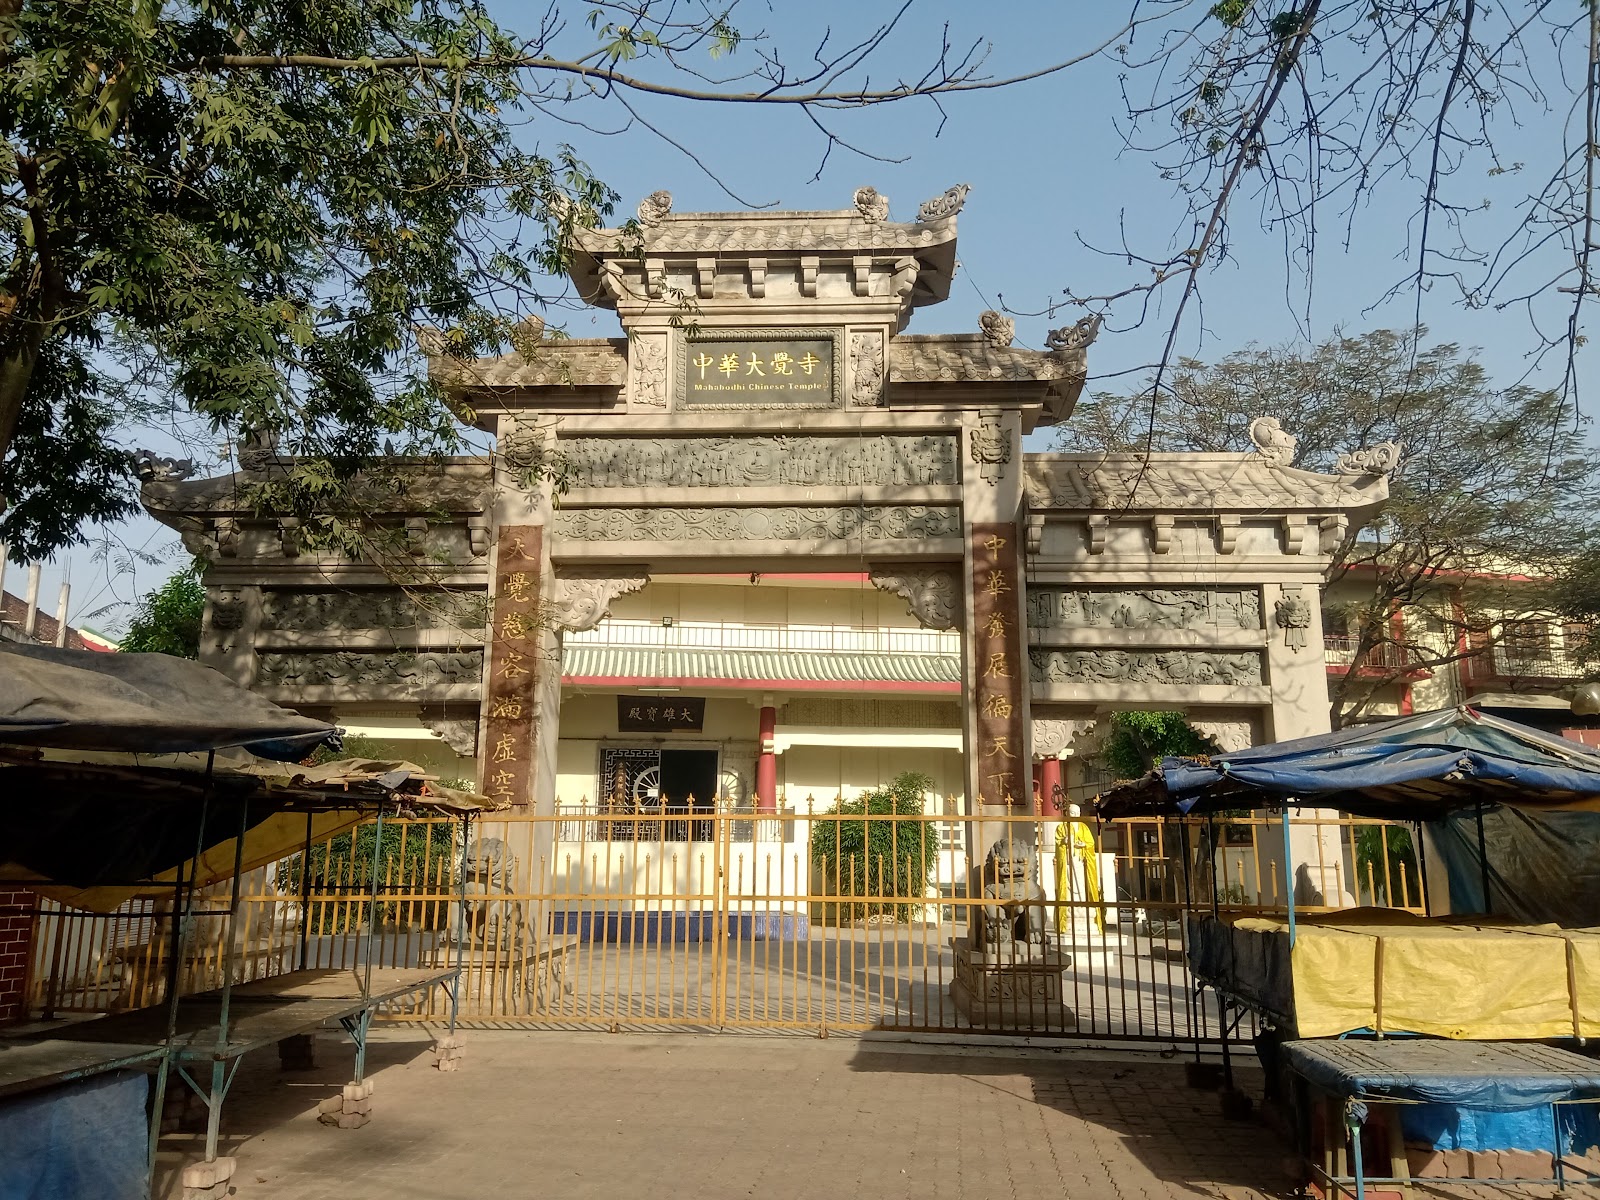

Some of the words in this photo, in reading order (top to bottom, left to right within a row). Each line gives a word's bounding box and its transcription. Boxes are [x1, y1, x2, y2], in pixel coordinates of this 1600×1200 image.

[692, 351, 821, 380] 中華大覺寺
[694, 383, 746, 391] Mahabodhi
[748, 382, 785, 391] Chinese
[788, 382, 822, 391] Temple
